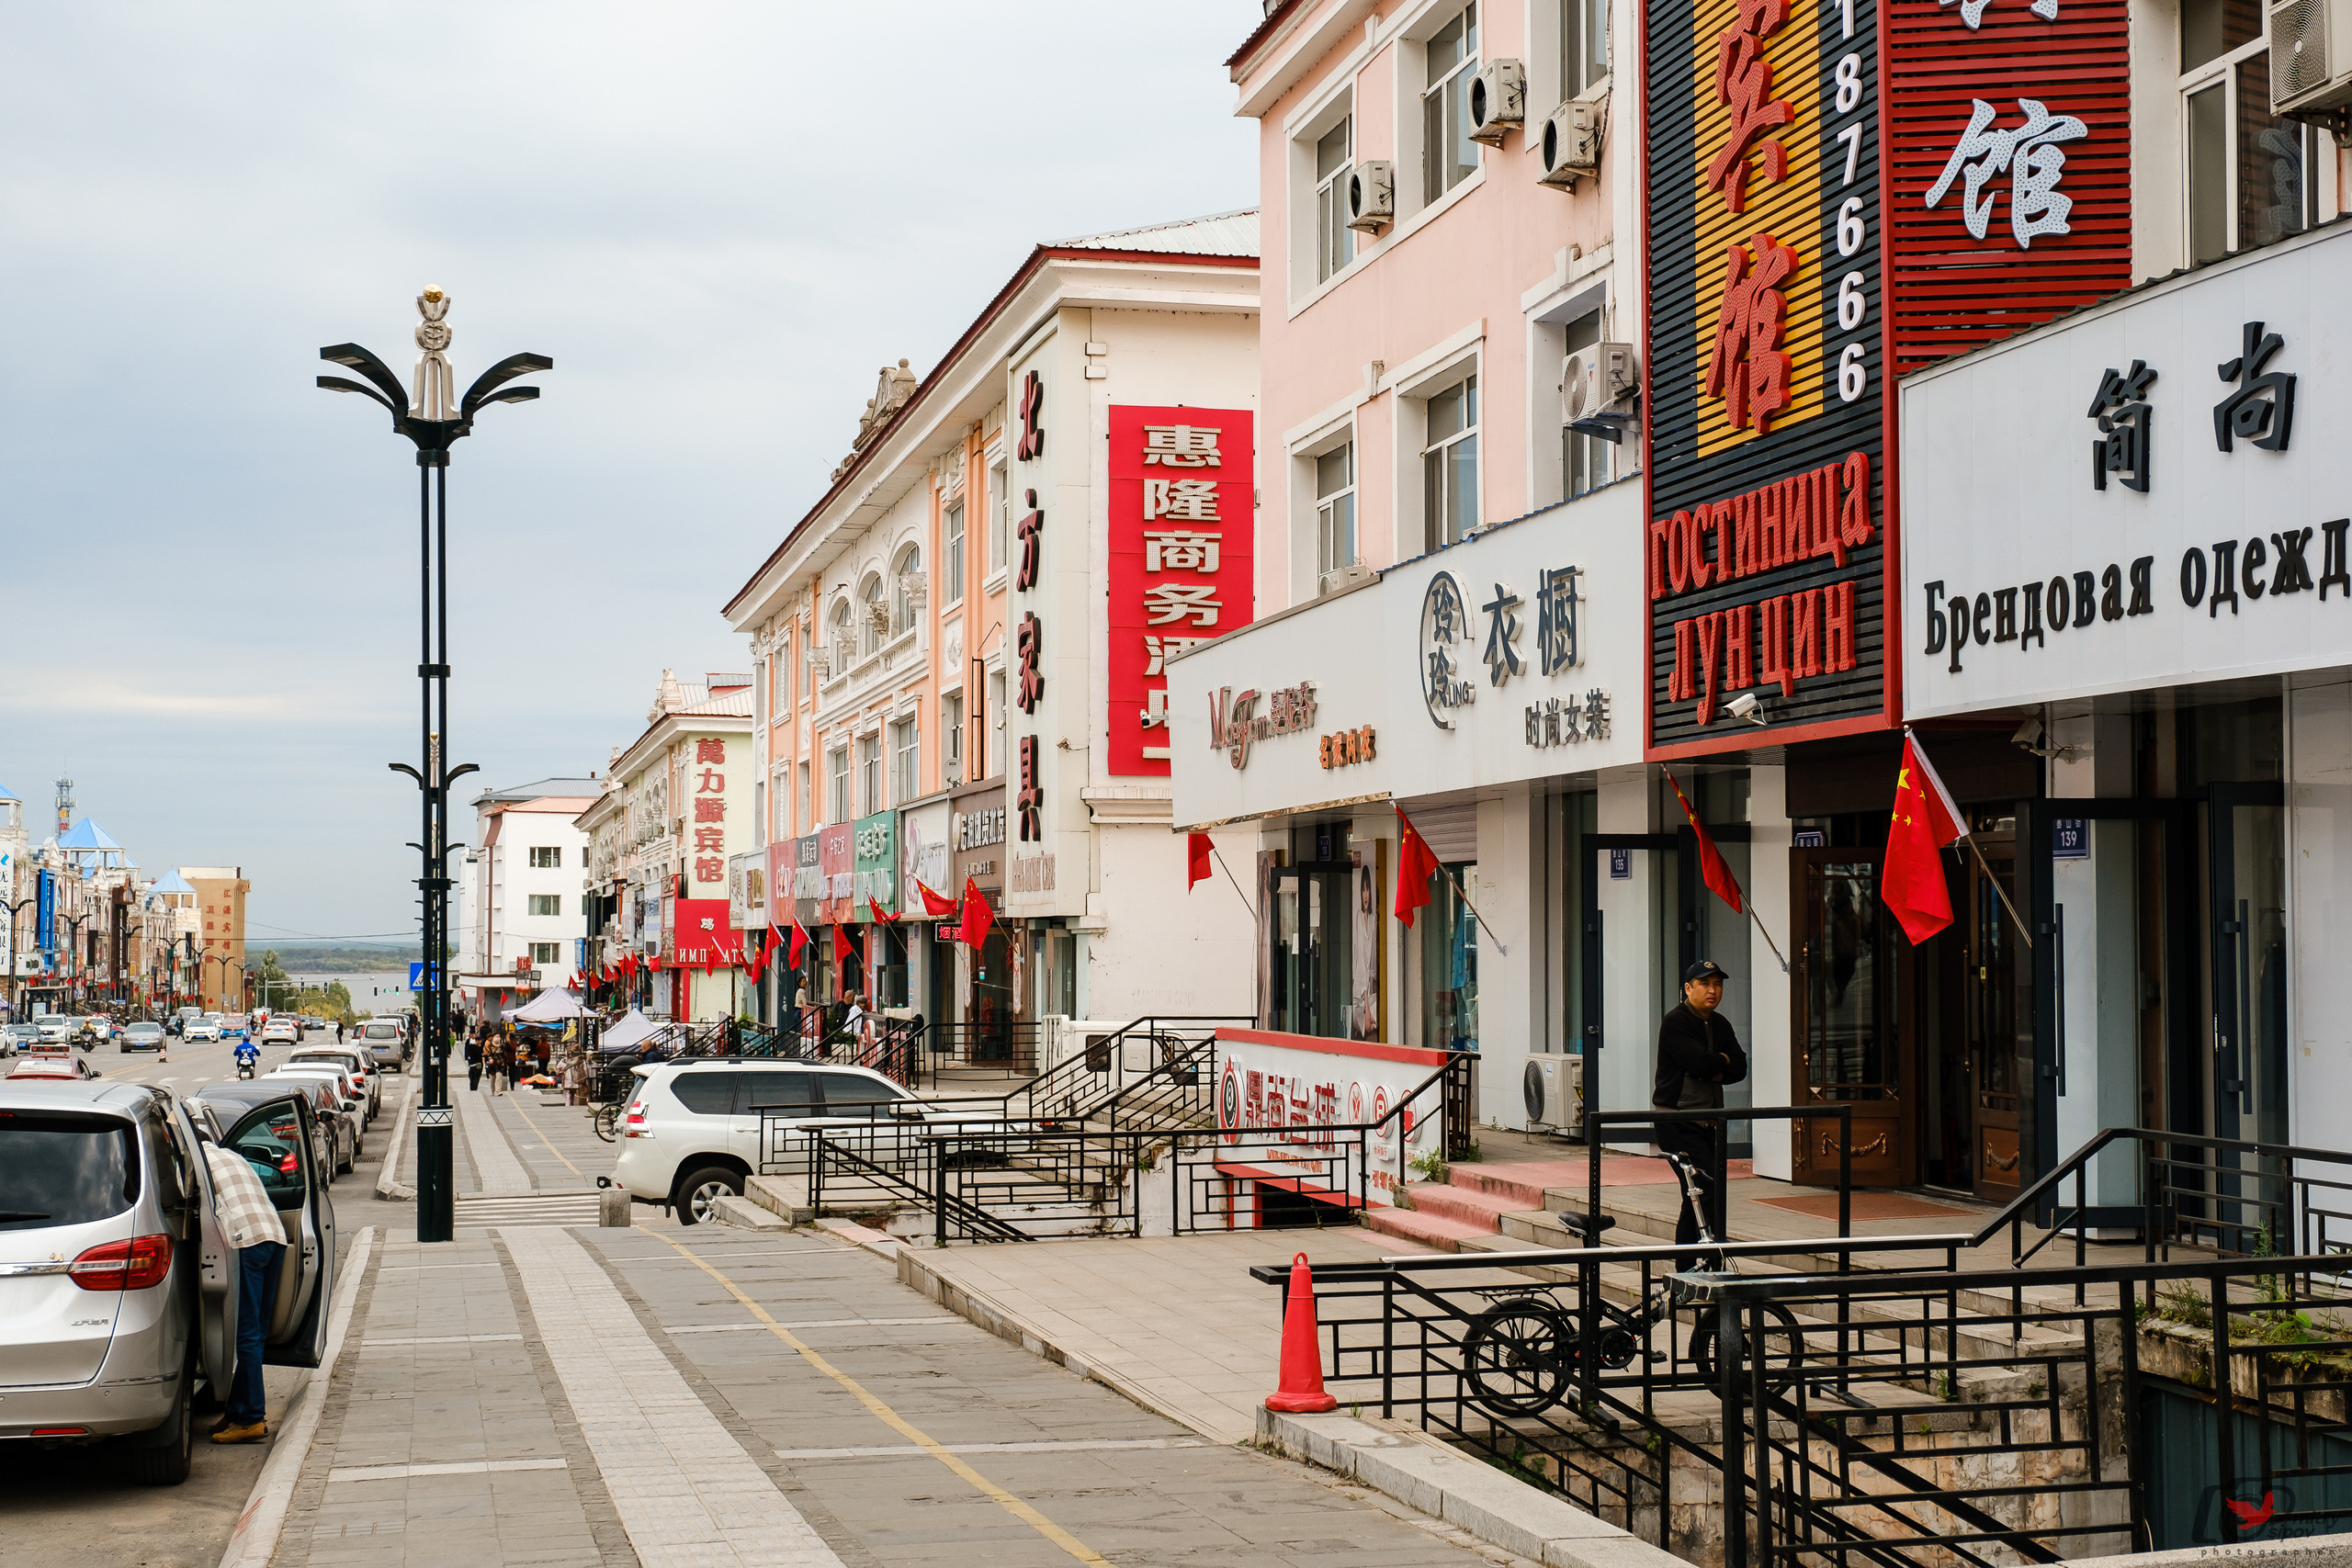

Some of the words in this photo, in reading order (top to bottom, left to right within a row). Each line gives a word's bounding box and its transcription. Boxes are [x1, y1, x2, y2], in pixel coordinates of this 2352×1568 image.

[1926, 0, 2089, 249] 馆
[2087, 321, 2297, 492] 简尚
[1017, 369, 1045, 841] 北方家具
[1429, 581, 1461, 708] 玲玲
[1482, 565, 1586, 687] 衣橱
[1924, 555, 2154, 673] Брендовая
[1449, 681, 1476, 707] LING
[1525, 688, 1611, 749] 时尚女装
[1615, 859, 1624, 871] 135
[2061, 830, 2077, 847] 139
